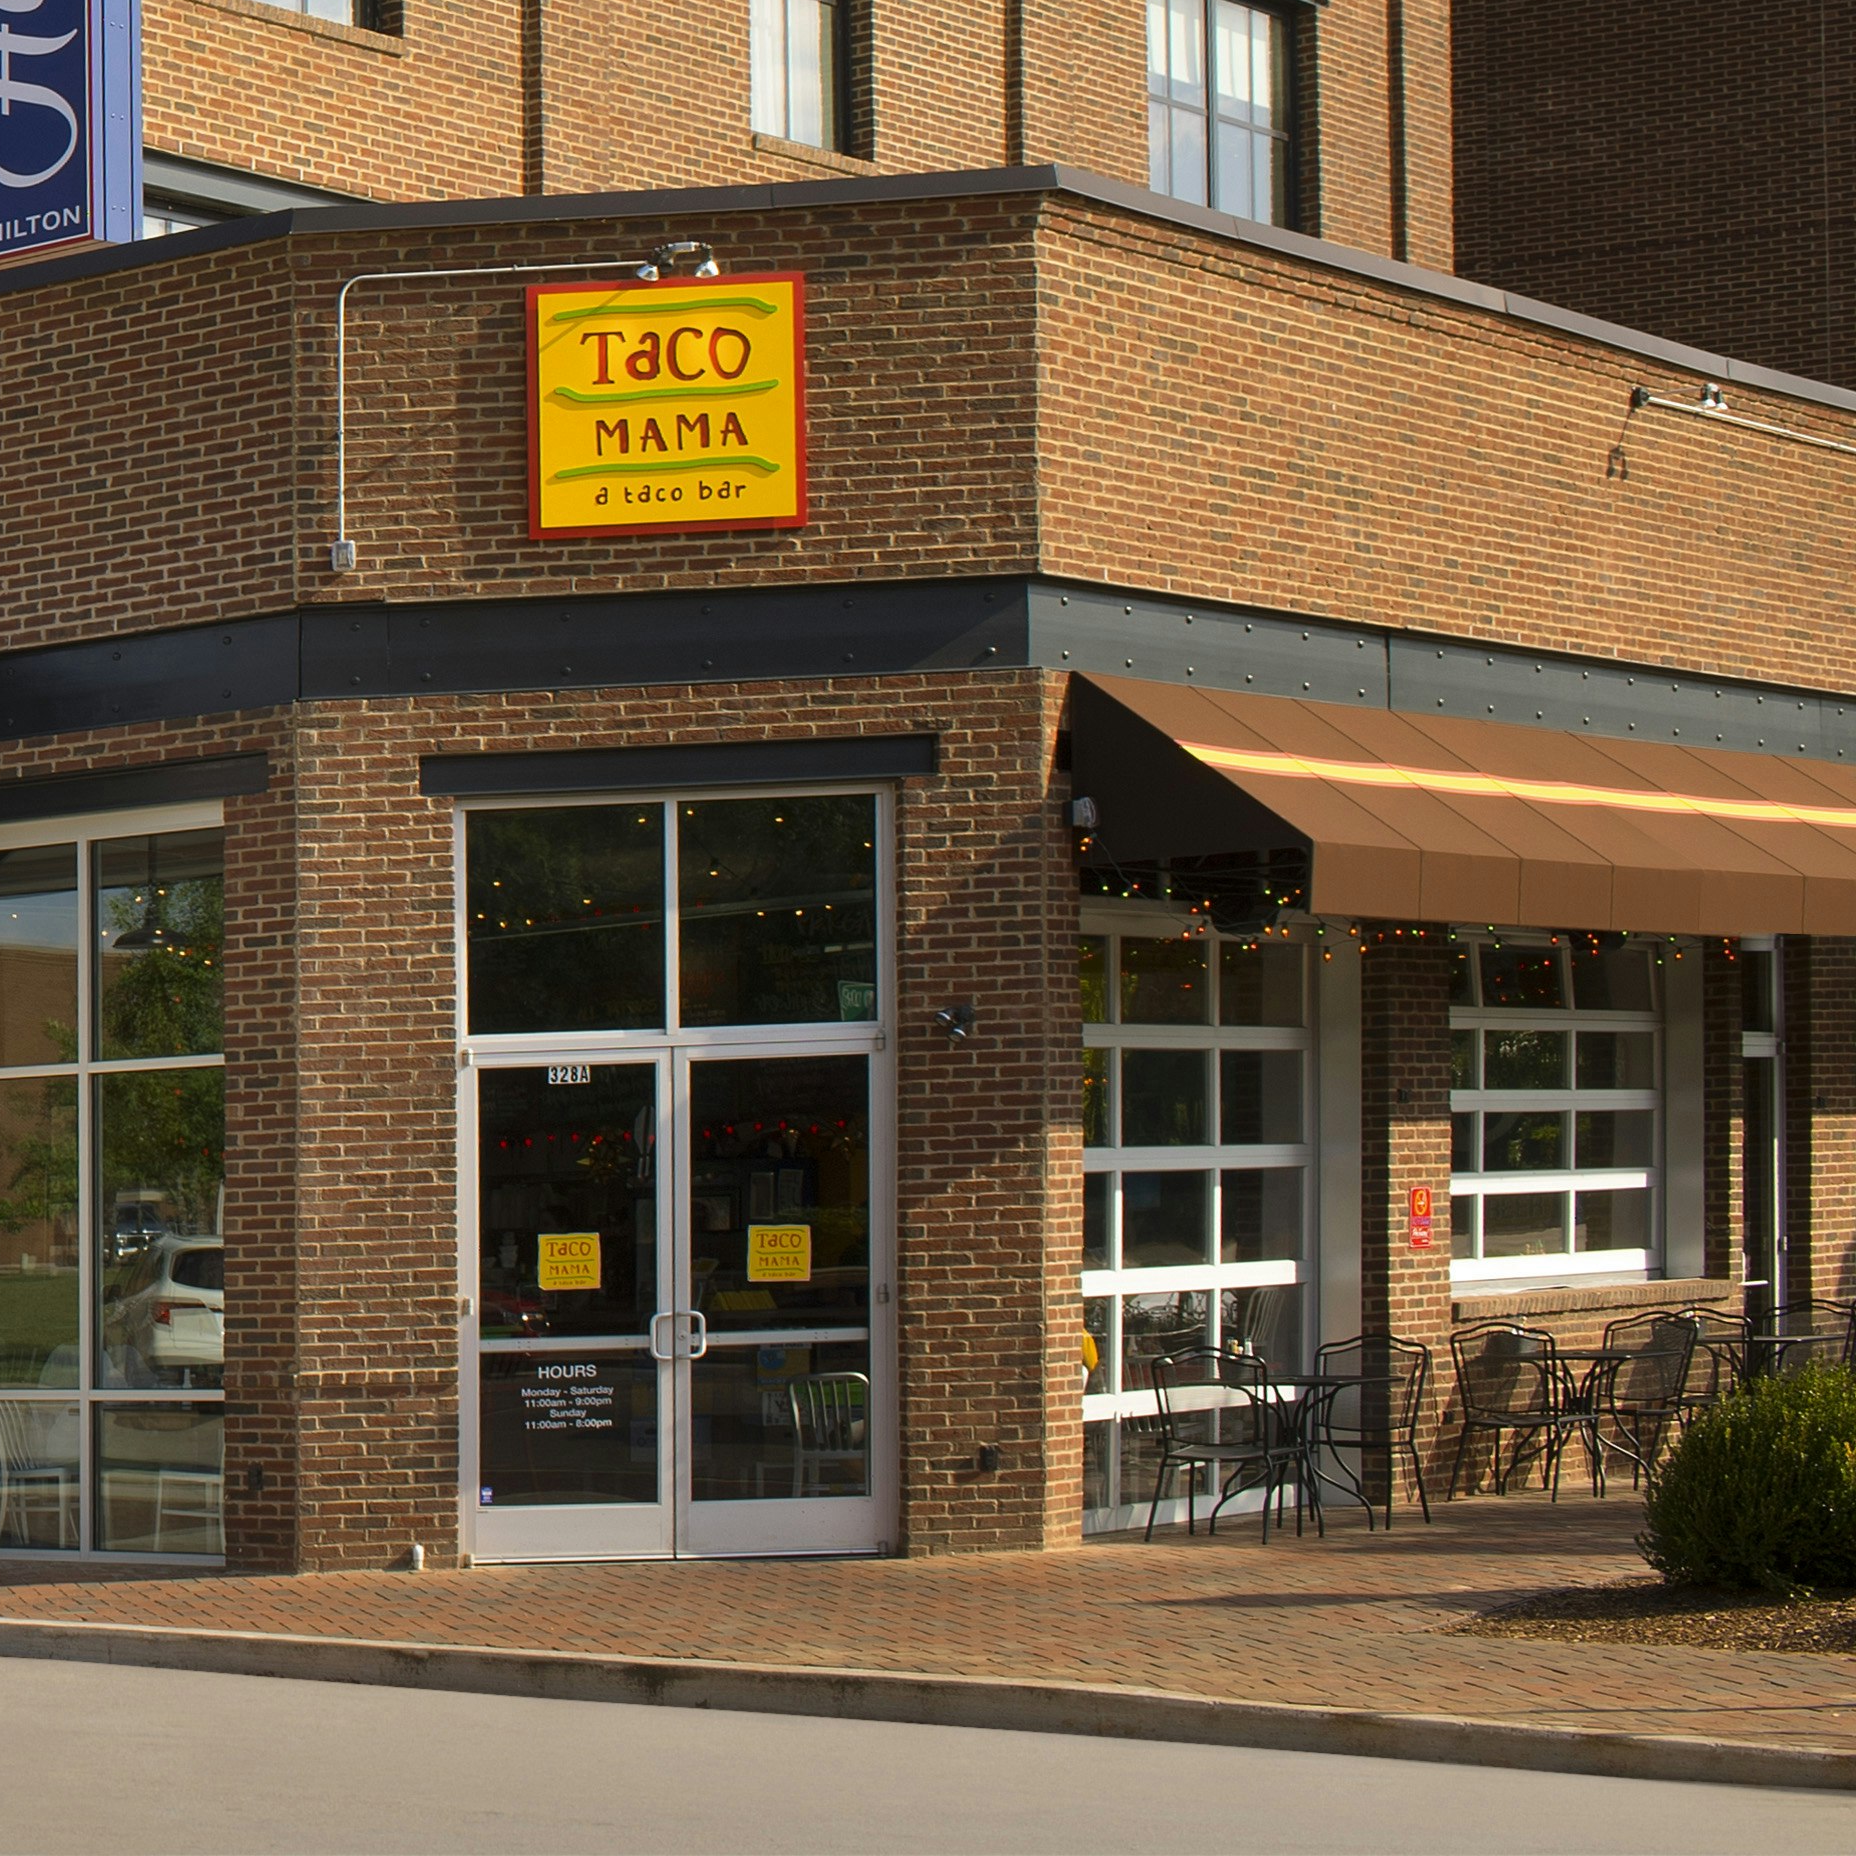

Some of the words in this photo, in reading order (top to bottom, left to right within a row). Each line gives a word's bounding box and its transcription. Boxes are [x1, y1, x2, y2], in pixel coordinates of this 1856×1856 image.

[594, 411, 749, 456] MAMA
[594, 487, 609, 506] a
[624, 484, 684, 504] taco
[698, 480, 747, 500] bar
[550, 1066, 588, 1082] 328A
[760, 1256, 800, 1266] MAMA
[549, 1264, 590, 1275] MAMA
[538, 1364, 597, 1379] HOURS
[521, 1388, 561, 1398] Monday
[570, 1386, 614, 1395] Saturday
[525, 1398, 566, 1408] 11:00am
[575, 1396, 612, 1406] 9:00pm
[549, 1408, 587, 1418] Sunday
[525, 1420, 567, 1429] 11:00am
[576, 1418, 612, 1429] 8:00pm
